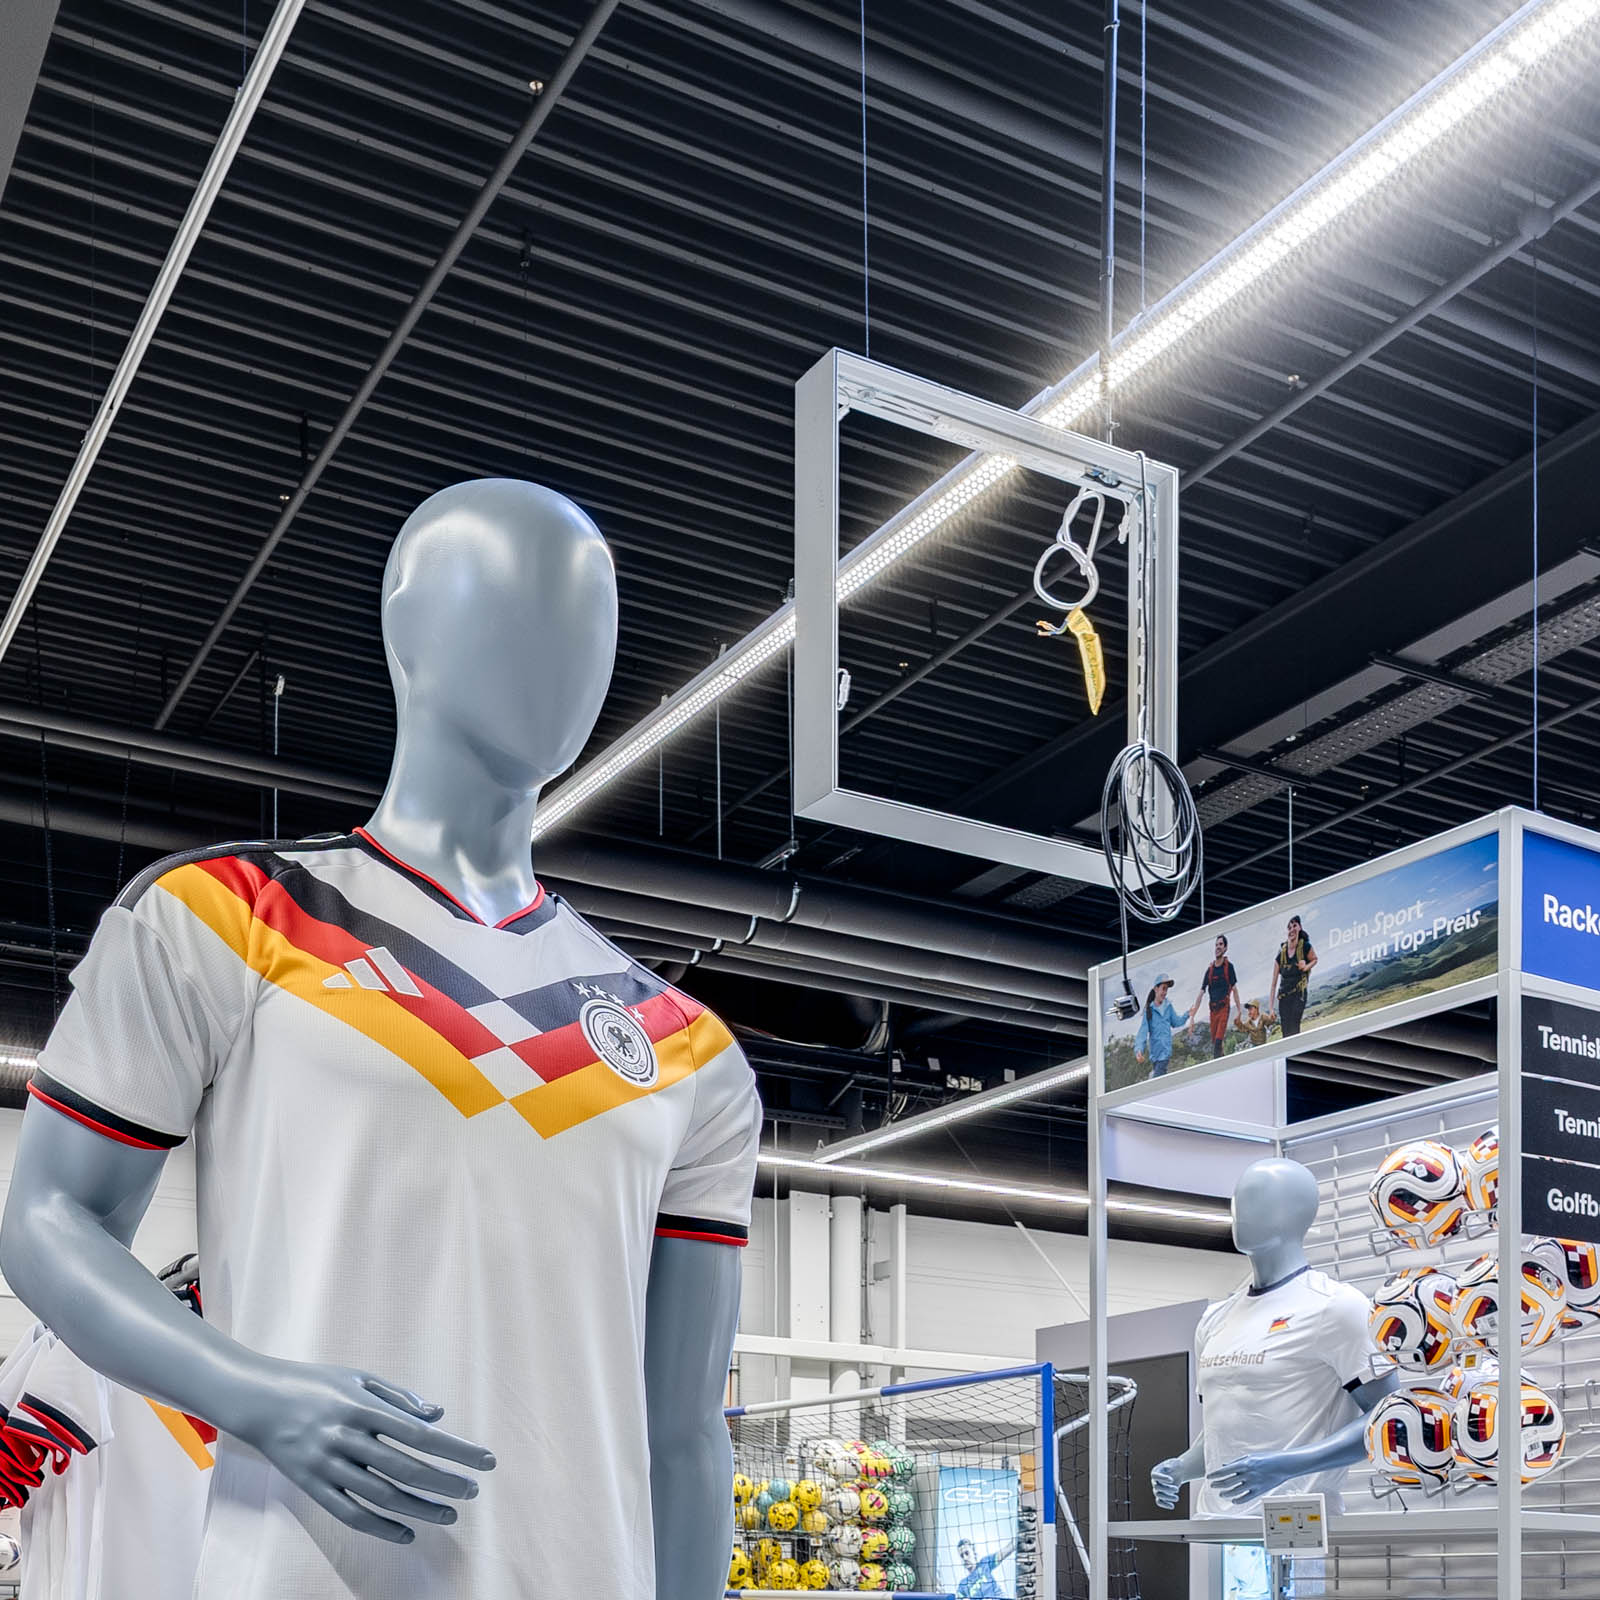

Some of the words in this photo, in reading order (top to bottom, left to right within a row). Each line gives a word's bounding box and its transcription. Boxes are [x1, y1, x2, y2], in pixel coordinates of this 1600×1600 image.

[1328, 919, 1368, 950] Dein
[1371, 899, 1424, 936] Sport
[1349, 940, 1389, 967] zum
[1391, 909, 1481, 960] Top-Preis
